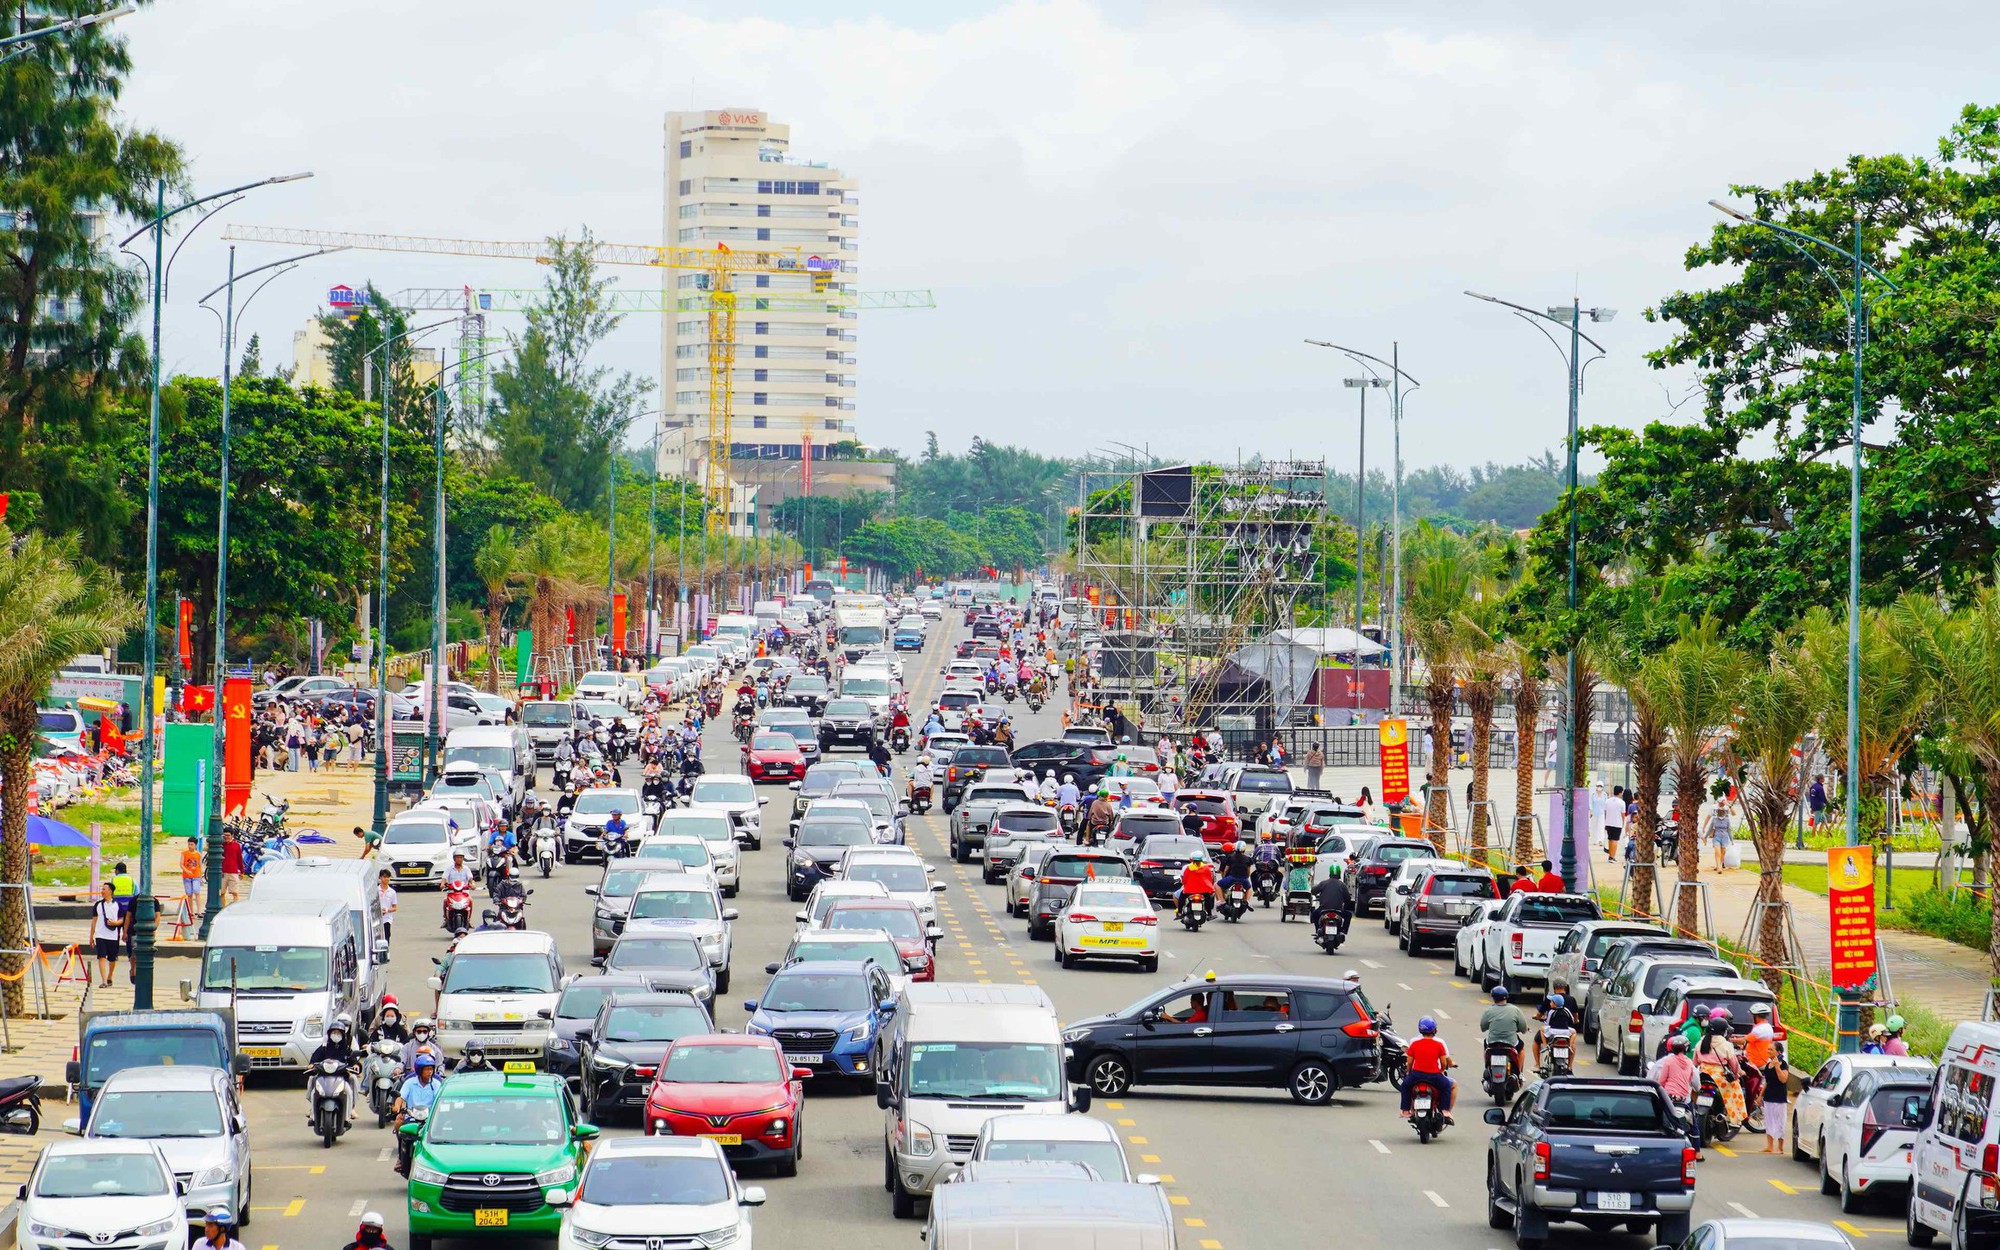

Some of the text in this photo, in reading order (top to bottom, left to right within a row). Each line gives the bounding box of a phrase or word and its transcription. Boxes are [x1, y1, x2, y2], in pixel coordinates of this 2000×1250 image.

[734, 114, 758, 124] VIAS
[330, 290, 353, 302] DIC
[479, 1217, 505, 1225] 204.25
